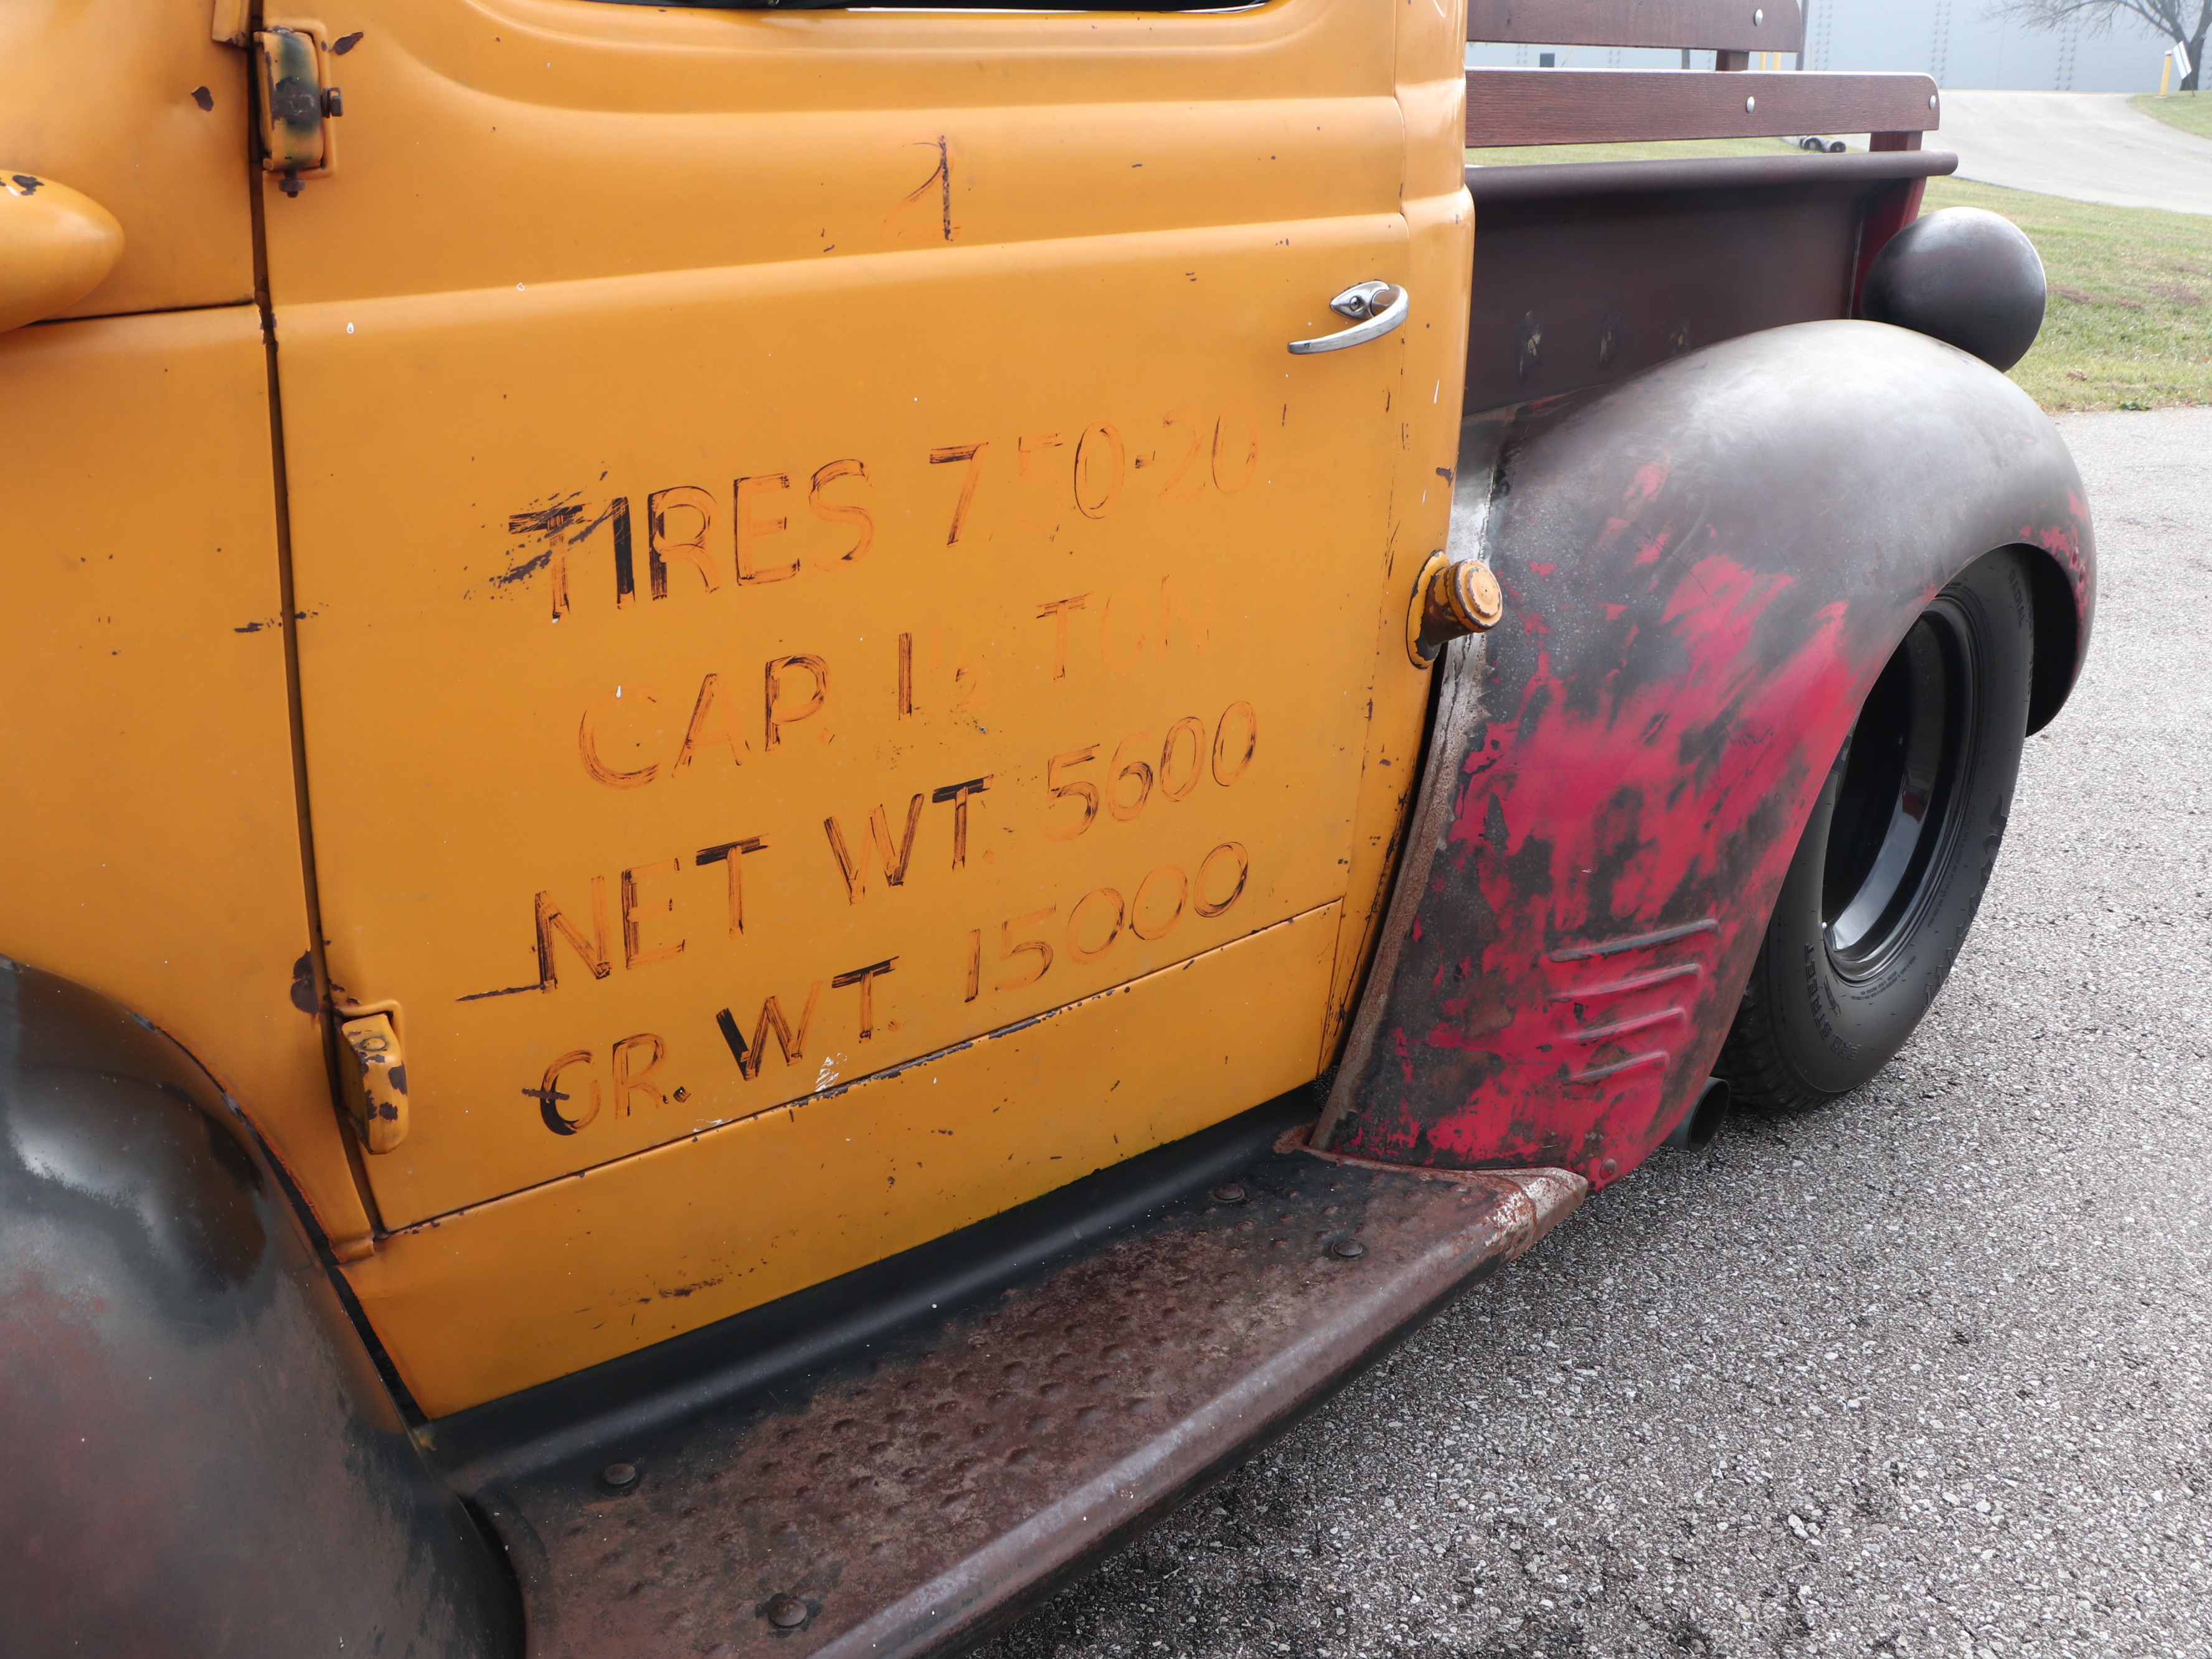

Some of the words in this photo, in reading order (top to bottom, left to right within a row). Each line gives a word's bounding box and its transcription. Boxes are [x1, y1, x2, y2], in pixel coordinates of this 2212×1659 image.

[509, 458, 874, 621] TIRES
[1035, 568, 1214, 687] TON
[534, 833, 770, 994] NET
[1045, 700, 1257, 842] 5600
[965, 841, 1249, 1003] 15000
[1805, 942, 1833, 1041] STREET
